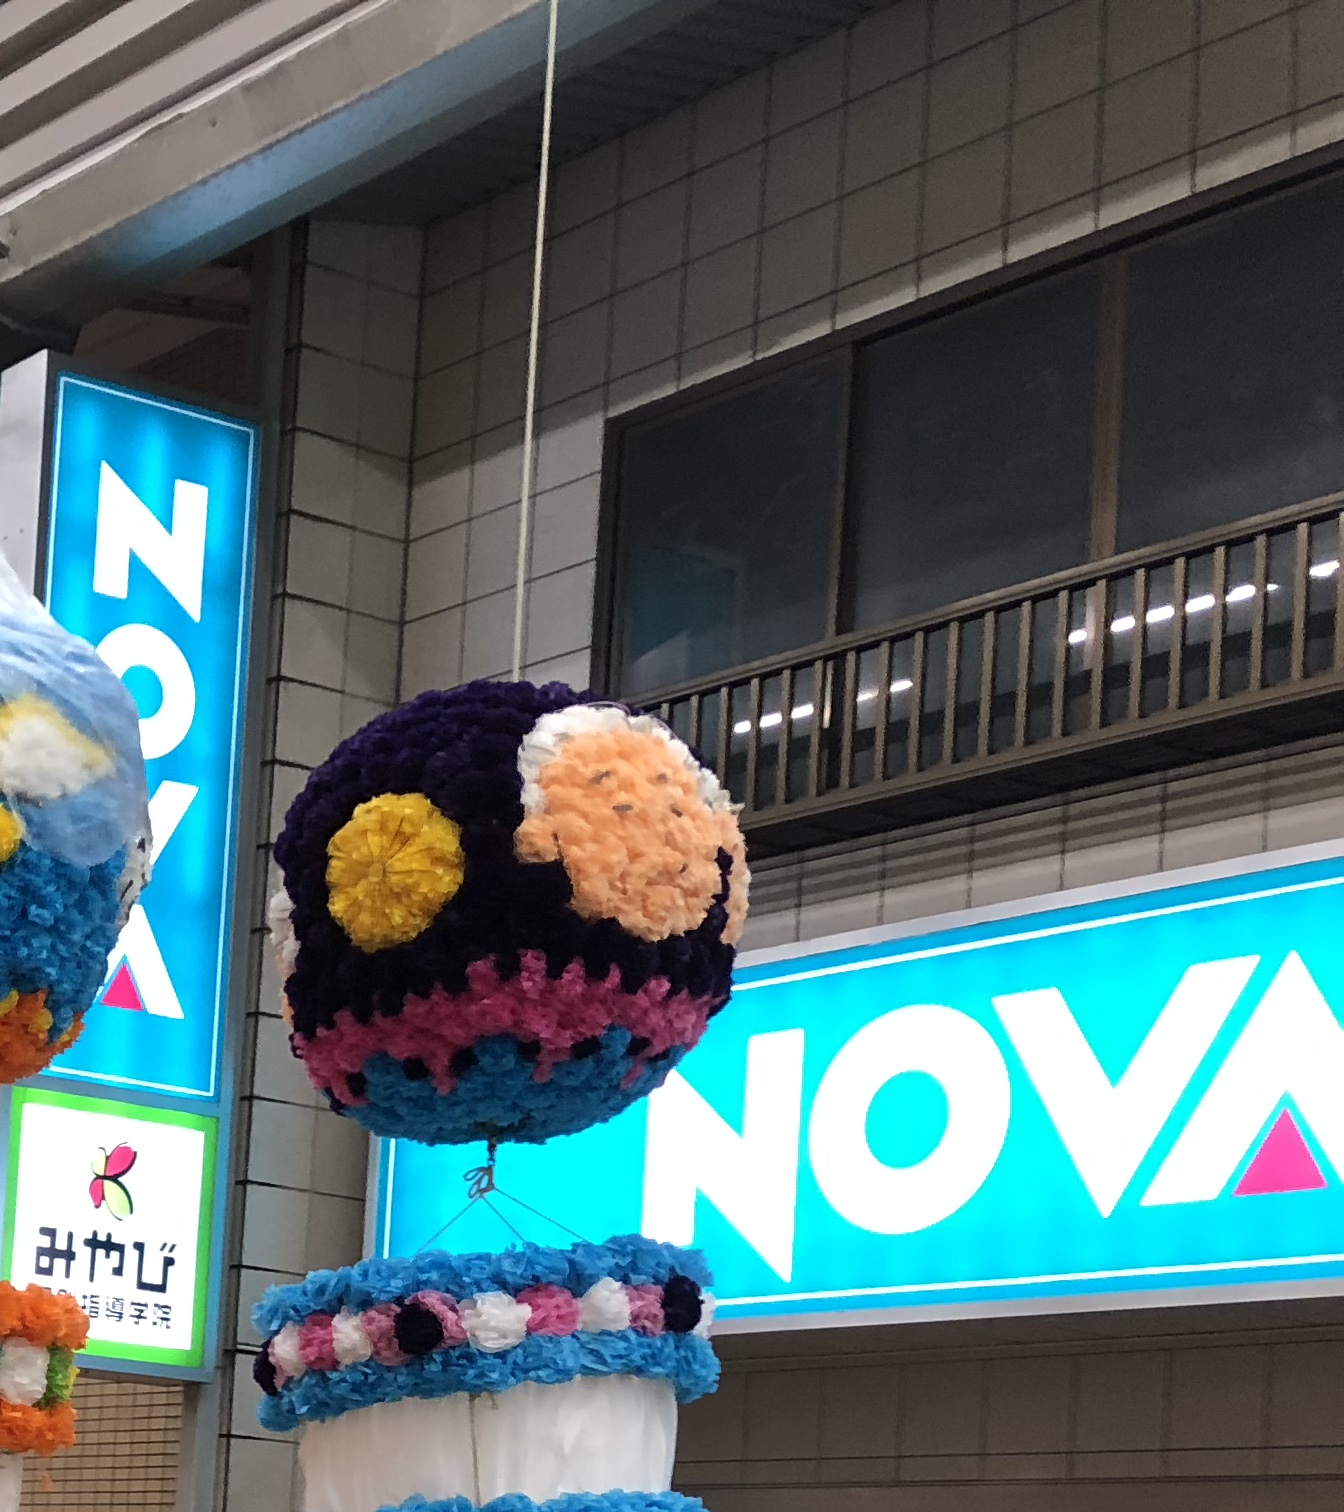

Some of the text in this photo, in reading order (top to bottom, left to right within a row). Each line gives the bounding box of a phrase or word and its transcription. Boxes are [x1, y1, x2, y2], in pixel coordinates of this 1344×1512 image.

[640, 948, 1344, 1284] NOVA
[35, 1226, 177, 1294] みやび
